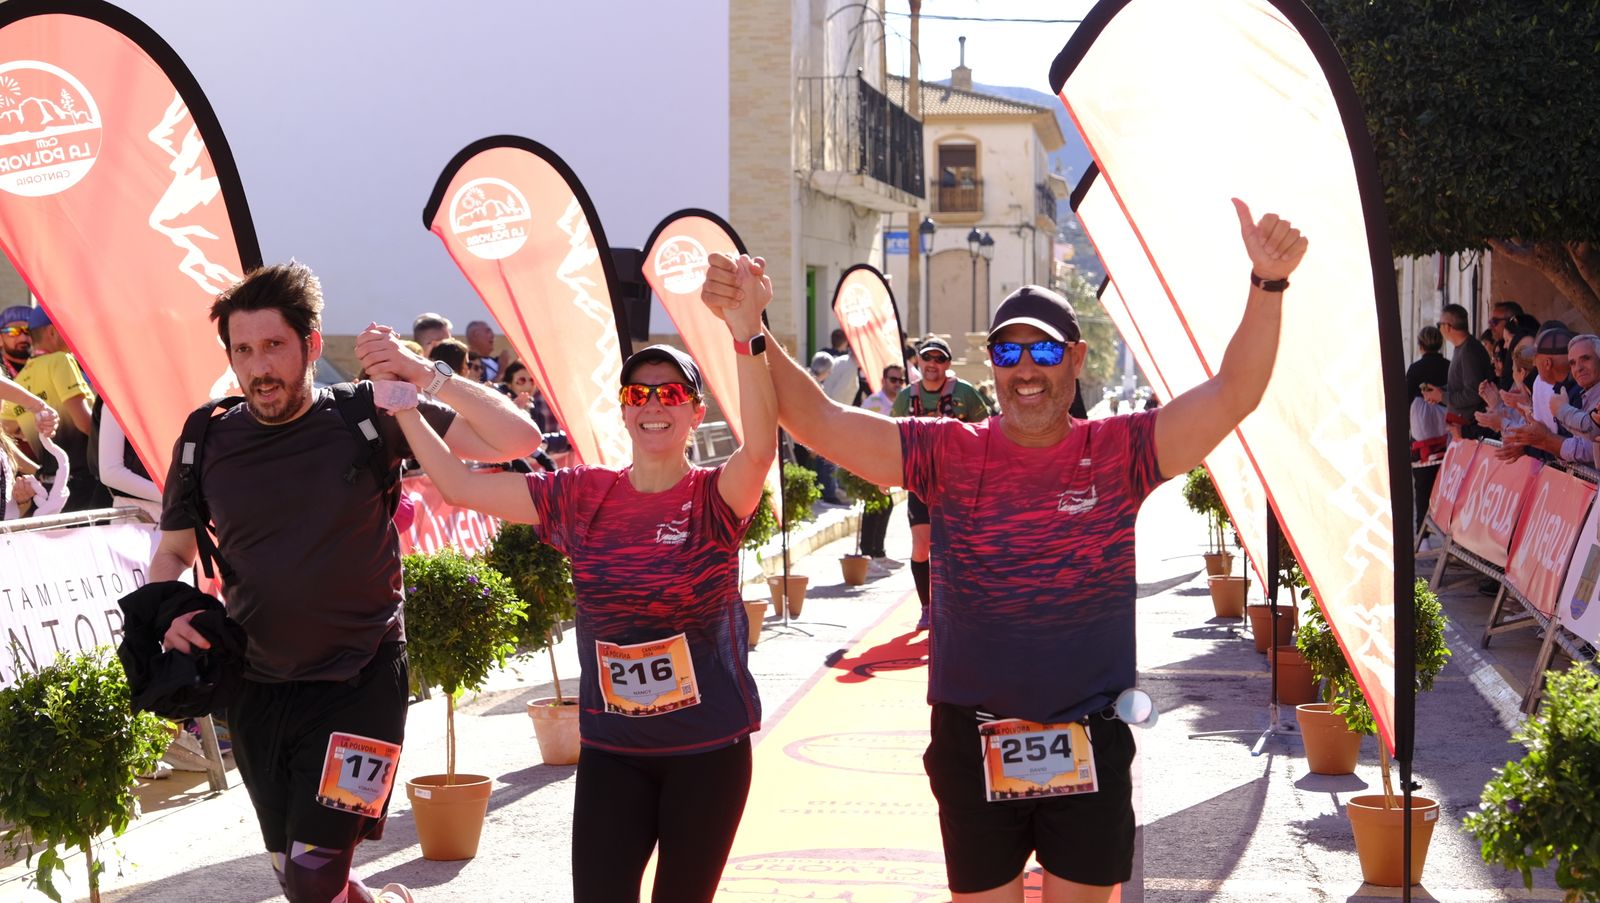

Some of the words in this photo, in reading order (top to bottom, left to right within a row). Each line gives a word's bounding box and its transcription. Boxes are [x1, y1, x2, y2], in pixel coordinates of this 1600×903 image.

[2, 572, 123, 612] TAMIENTO
[0, 608, 125, 683] NTOR
[610, 658, 672, 685] 216
[1001, 734, 1072, 764] 254
